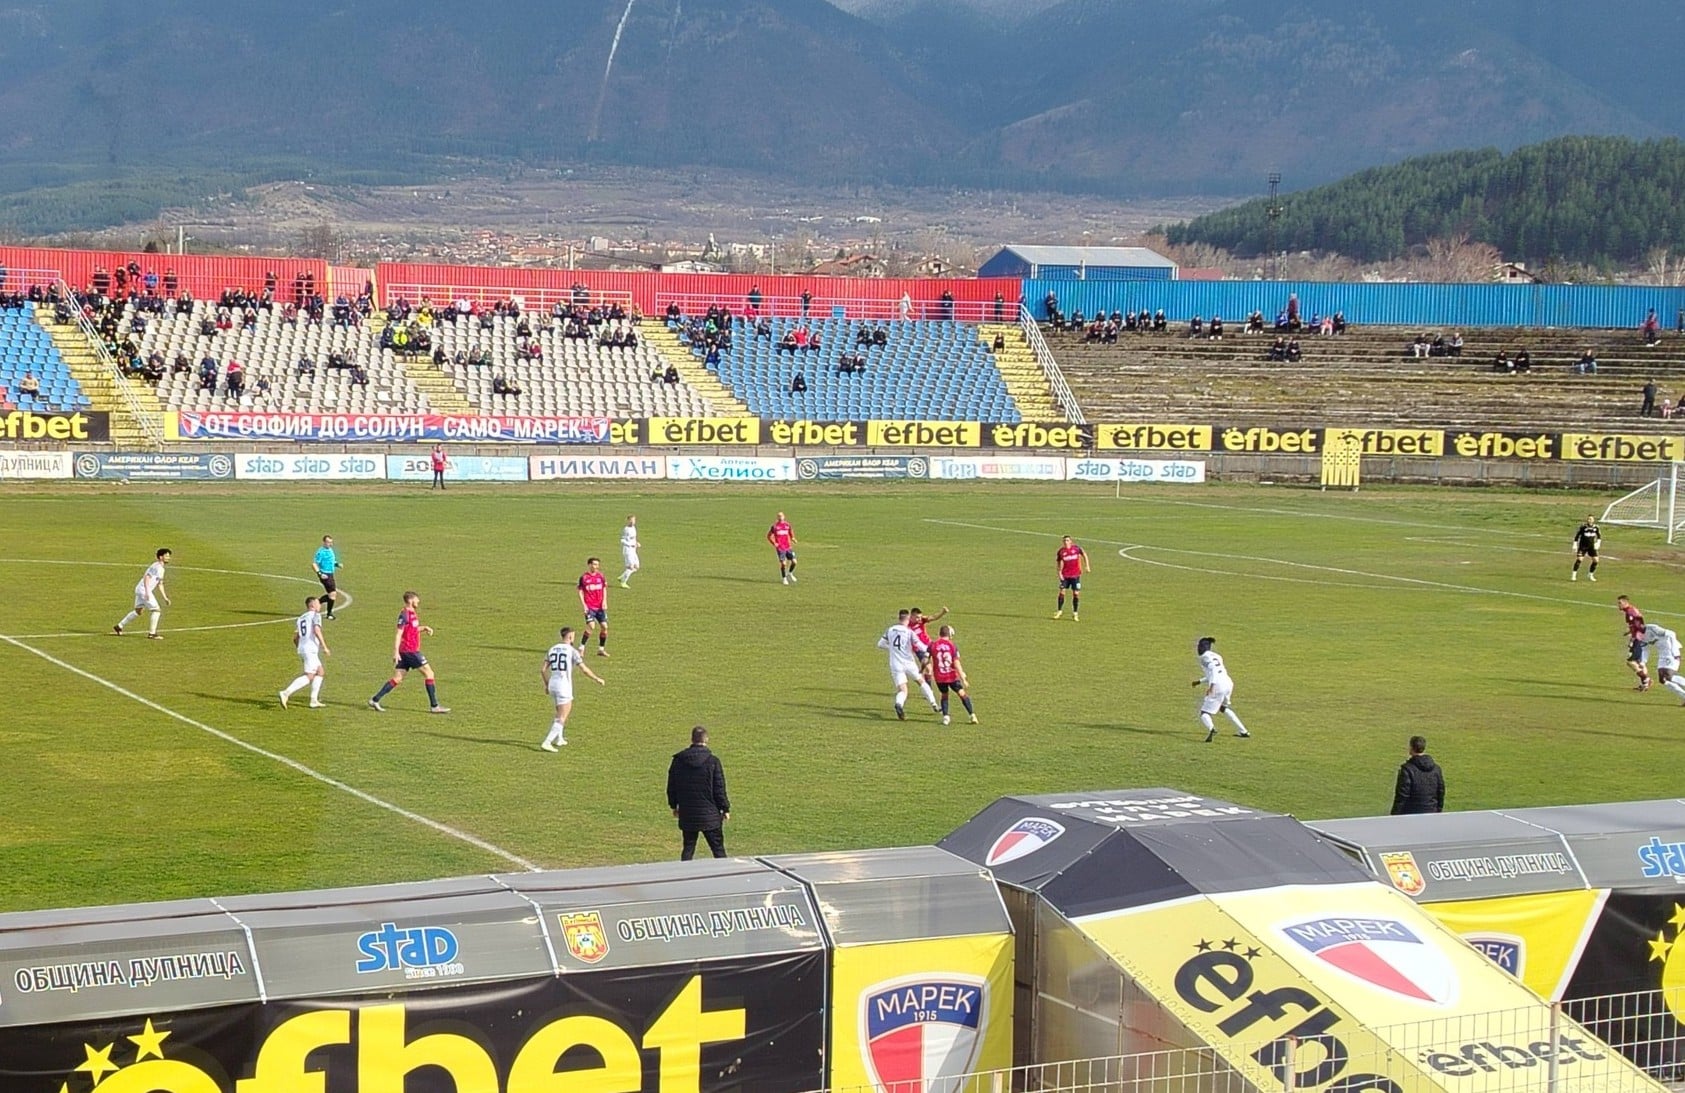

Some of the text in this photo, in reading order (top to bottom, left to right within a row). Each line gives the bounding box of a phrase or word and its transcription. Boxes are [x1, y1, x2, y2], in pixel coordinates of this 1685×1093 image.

[0, 411, 88, 438] fbet
[206, 415, 234, 434] ОТ
[238, 416, 313, 436] СОФИЯ
[318, 417, 348, 437] ДО
[354, 417, 424, 437] СОЛУН
[444, 418, 500, 438] САМО
[1, 458, 60, 472] ДУПНИЦА
[540, 460, 657, 475] НИКМАН
[689, 458, 776, 478] Хелиос
[300, 619, 307, 637] 6
[893, 634, 902, 651] 4
[550, 653, 568, 671] 26
[1428, 852, 1573, 882] ОБЩИНА ДУПНИЦА
[617, 904, 806, 942] ОБЩИНА ДУПНИЦА
[1294, 918, 1401, 941] МАРЕК
[15, 951, 245, 993] ОБЩИНА ДУПНИЦА
[877, 986, 975, 1021] МАРЕК
[914, 1010, 937, 1022] 1915
